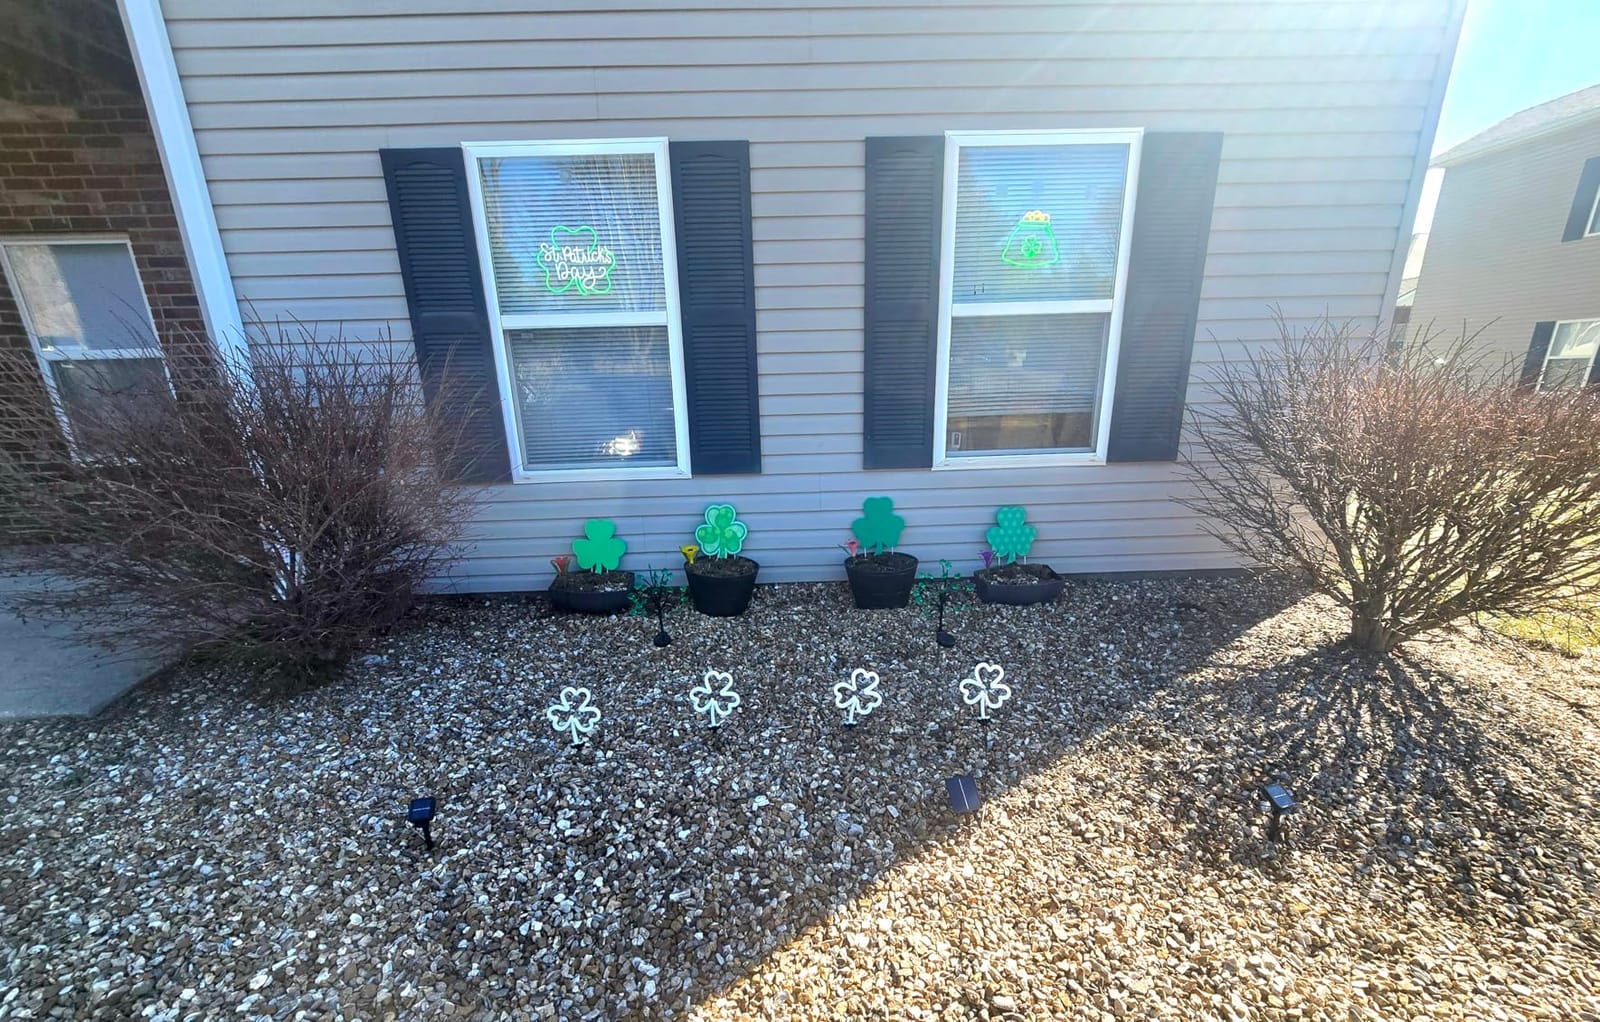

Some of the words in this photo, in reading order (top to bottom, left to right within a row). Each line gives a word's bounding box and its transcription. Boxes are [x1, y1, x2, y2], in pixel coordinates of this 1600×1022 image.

[540, 243, 563, 262] St.
[562, 246, 612, 264] Patrick's
[555, 262, 606, 289] Day
